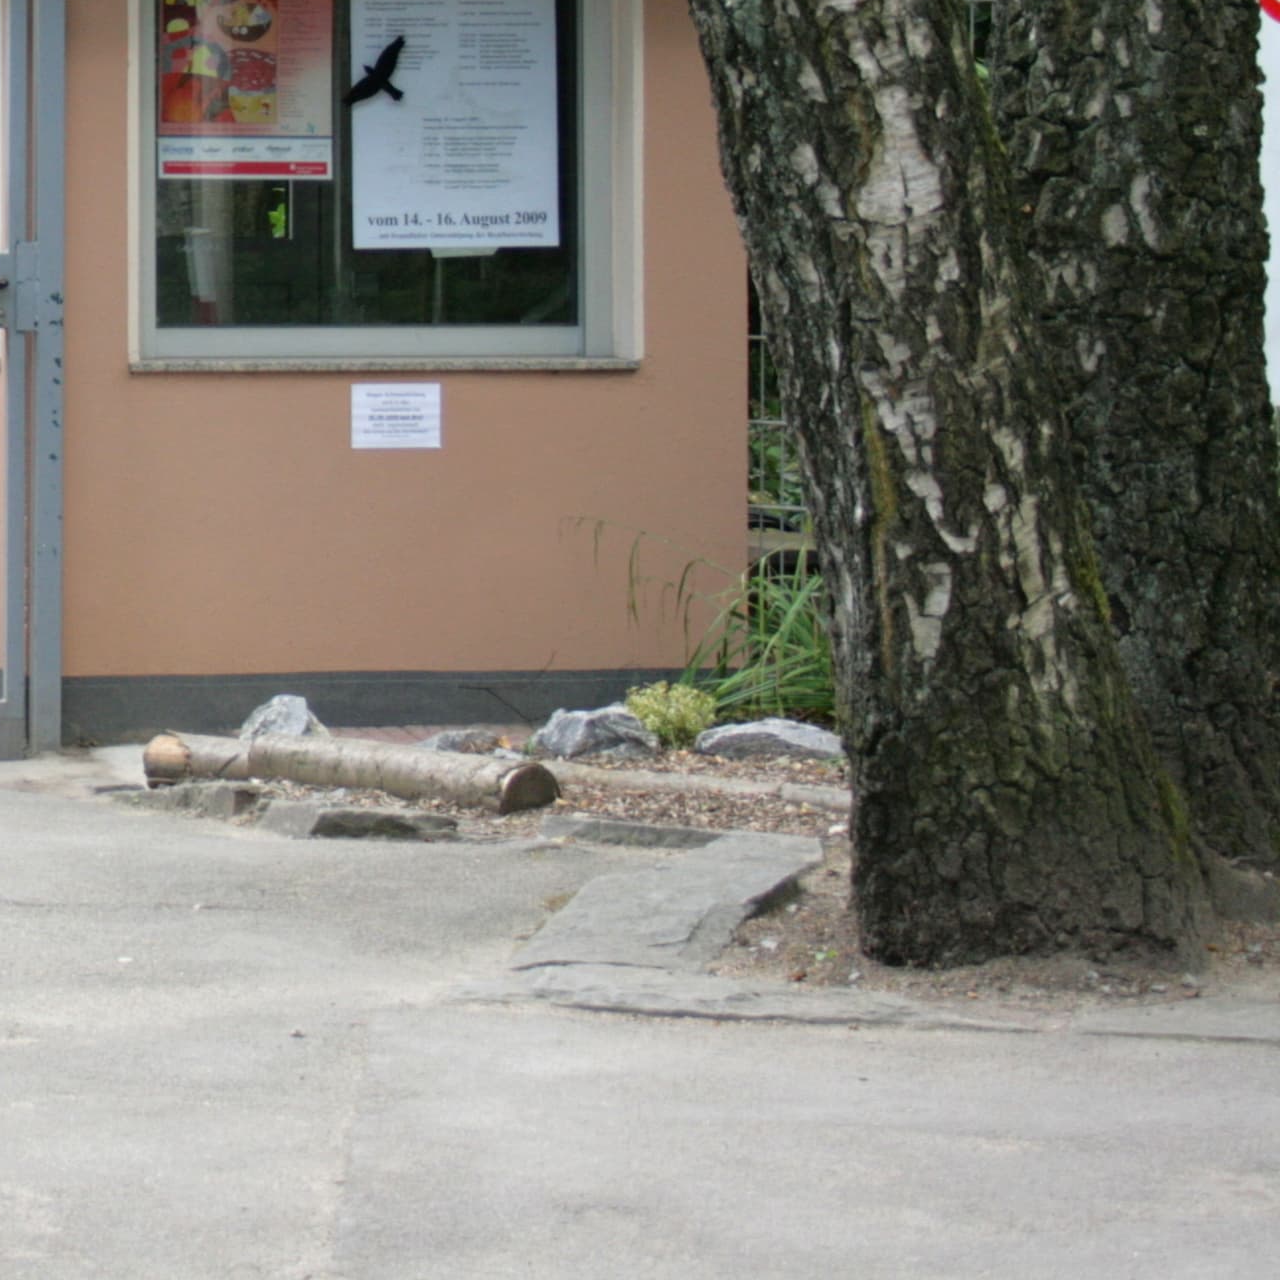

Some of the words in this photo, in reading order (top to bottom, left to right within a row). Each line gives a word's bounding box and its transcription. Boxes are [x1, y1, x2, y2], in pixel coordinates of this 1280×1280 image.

[367, 215, 399, 227] vom
[460, 211, 511, 229] August
[514, 211, 548, 226] 2009
